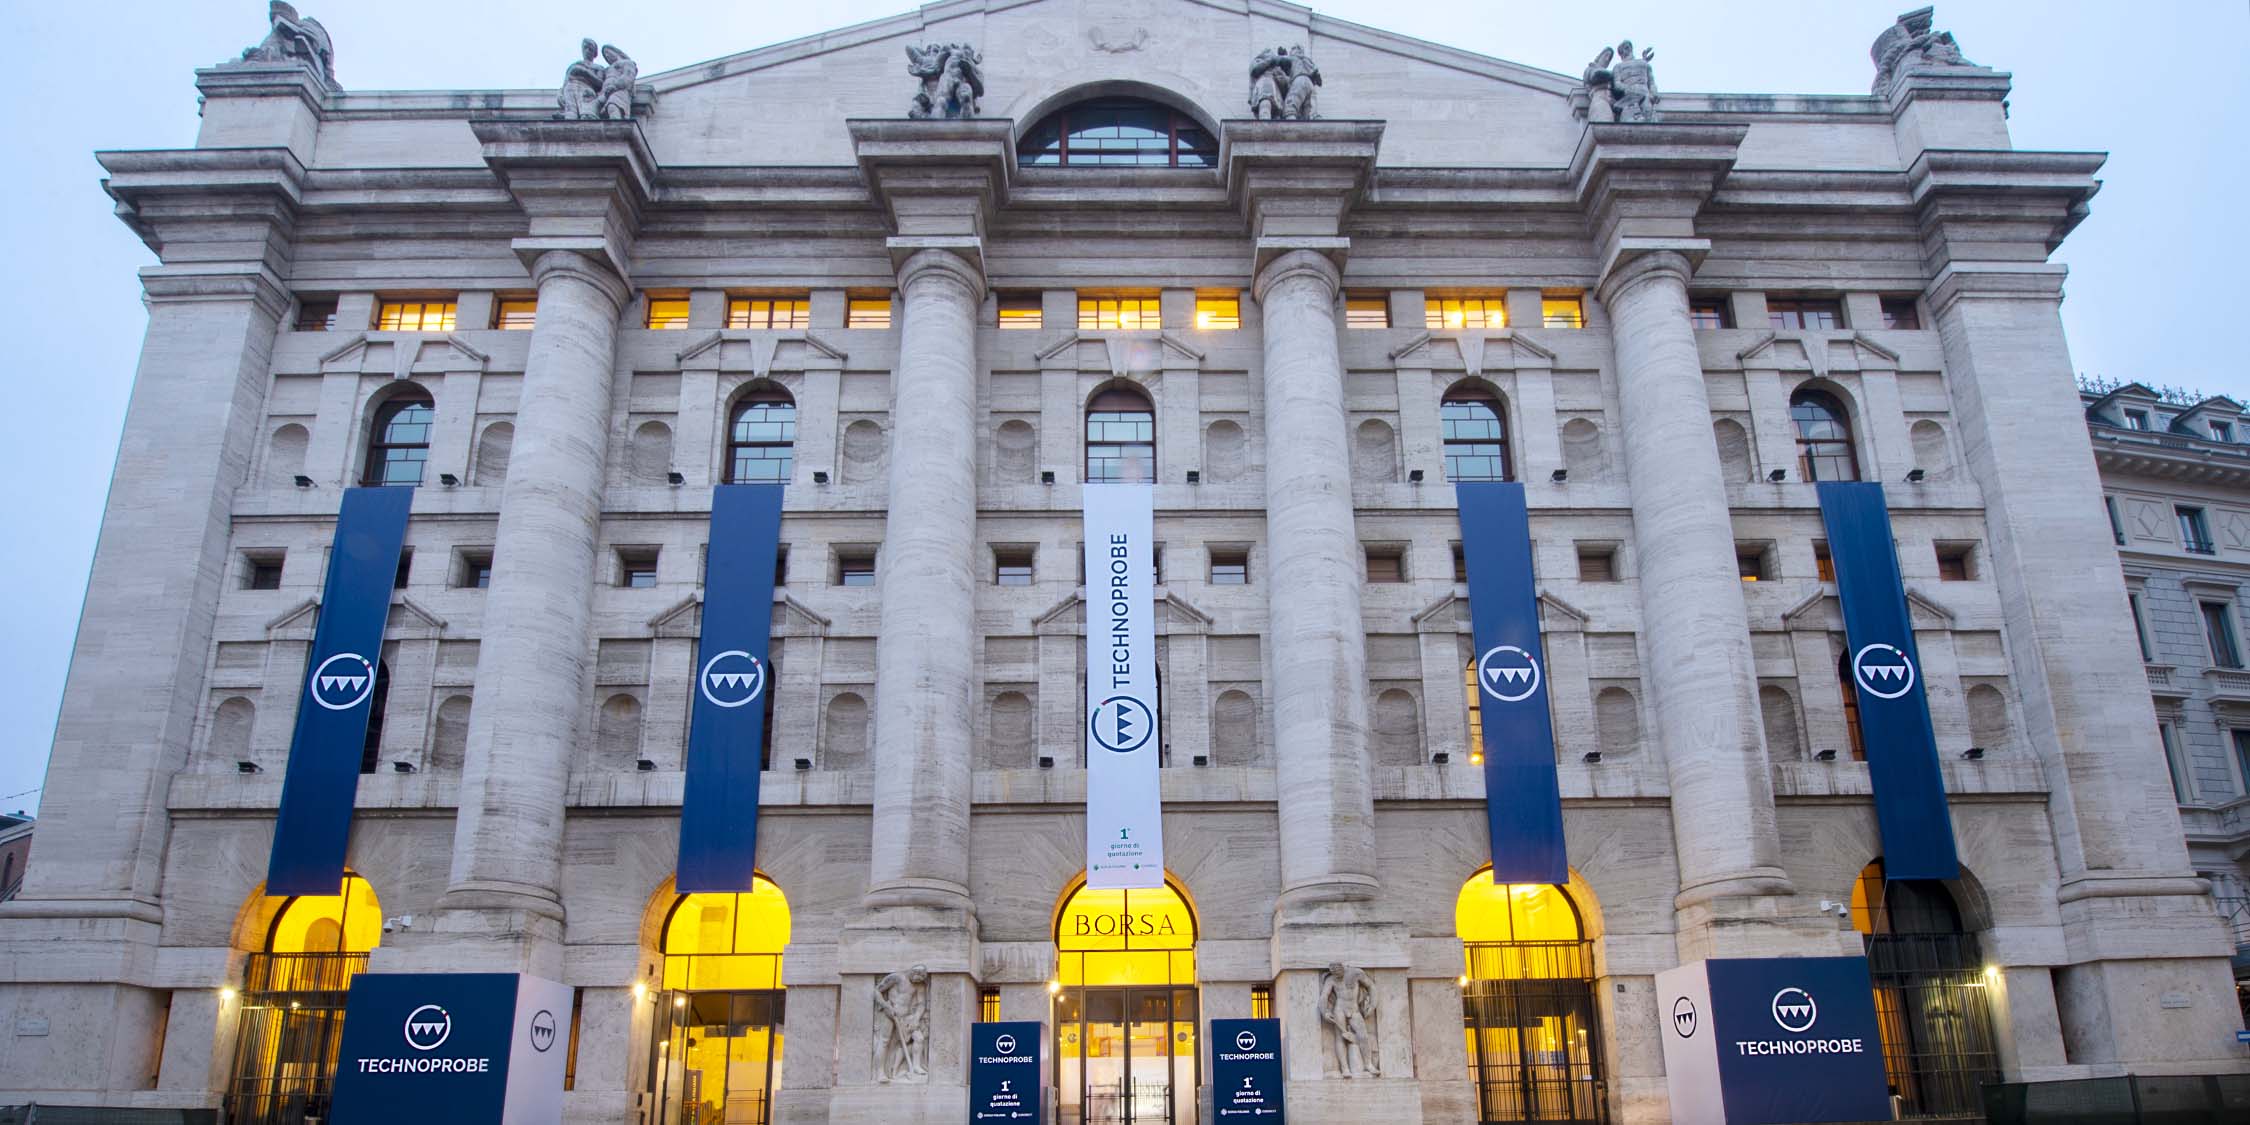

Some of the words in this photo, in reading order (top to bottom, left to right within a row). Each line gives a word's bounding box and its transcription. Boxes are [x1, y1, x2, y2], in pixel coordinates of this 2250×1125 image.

[1111, 534, 1130, 689] TECHNOPROBE
[1107, 850, 1143, 858] quotazione
[1075, 914, 1175, 936] BORSA
[1736, 1039, 1863, 1056] TECHNOPROBE
[979, 1056, 1033, 1064] TECHNOPROBE
[1220, 1053, 1274, 1061] TECHNOPROBE
[358, 1058, 489, 1073] TECHNOPROBE
[992, 1093, 1011, 1101] giorno
